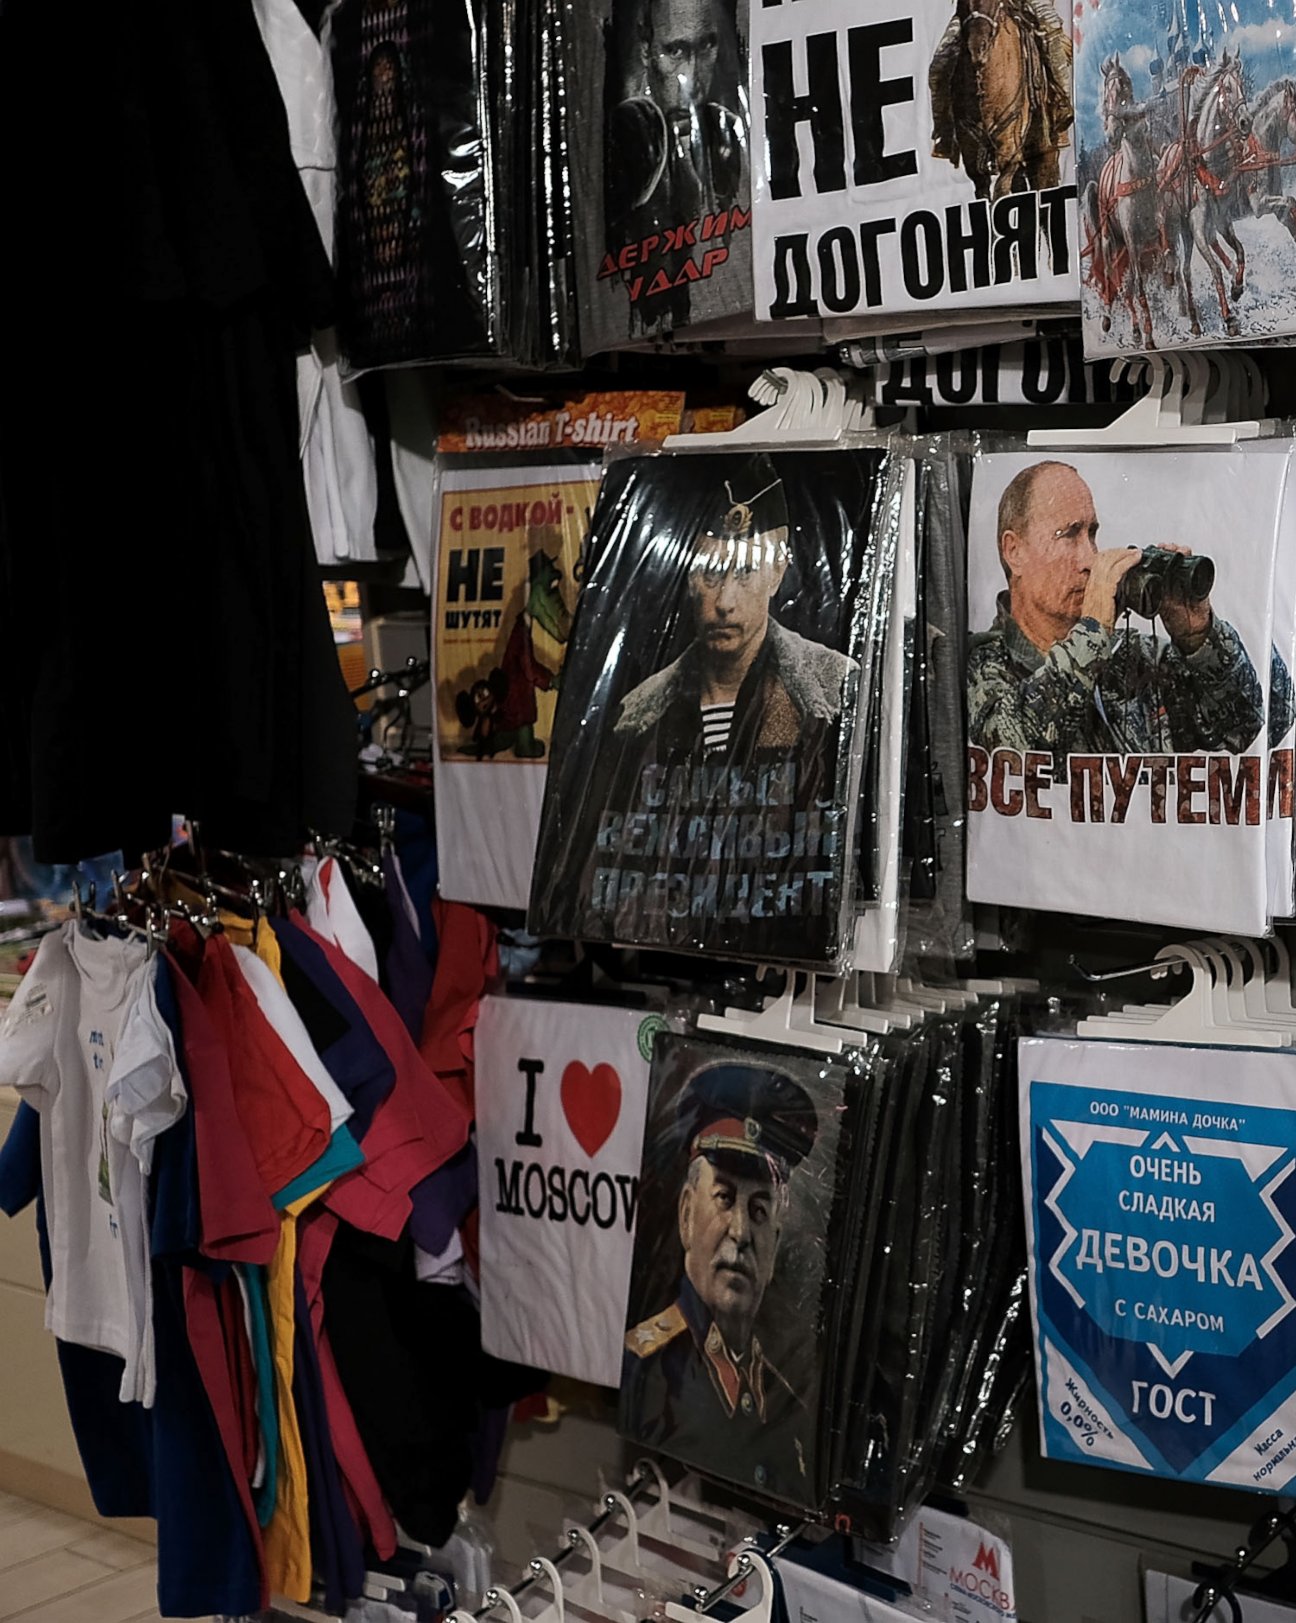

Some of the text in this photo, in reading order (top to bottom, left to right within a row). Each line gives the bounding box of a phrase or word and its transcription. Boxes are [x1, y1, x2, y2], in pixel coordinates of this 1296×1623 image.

[761, 17, 920, 200] НЕ
[627, 248, 730, 301] УДАР
[768, 184, 1077, 319] ДОГОНЯТ
[465, 411, 639, 448] Russian T-shirt
[450, 506, 464, 532] С
[469, 491, 562, 533] ВОДКОЙ
[446, 547, 505, 602] НЕ
[445, 609, 503, 630] ШУТЯТ
[967, 745, 1055, 819] ВСЕ
[1068, 751, 1263, 825] ПУТЕМ
[515, 1058, 545, 1148] I
[1089, 1101, 1246, 1131] ООО "МАМИНА ДОЧКА"
[1129, 1154, 1202, 1186] ОЧЕНЬ
[1118, 1189, 1216, 1223] СЛАДКАЯ
[1075, 1228, 1264, 1291] ДЕВОЧКА
[1115, 1299, 1224, 1333] С САХАРОМ
[1060, 1400, 1095, 1447] 0,0%
[1064, 1377, 1114, 1440] Жирность
[1131, 1380, 1217, 1426] ГОСТ
[949, 1567, 1016, 1611] МОСКВ
